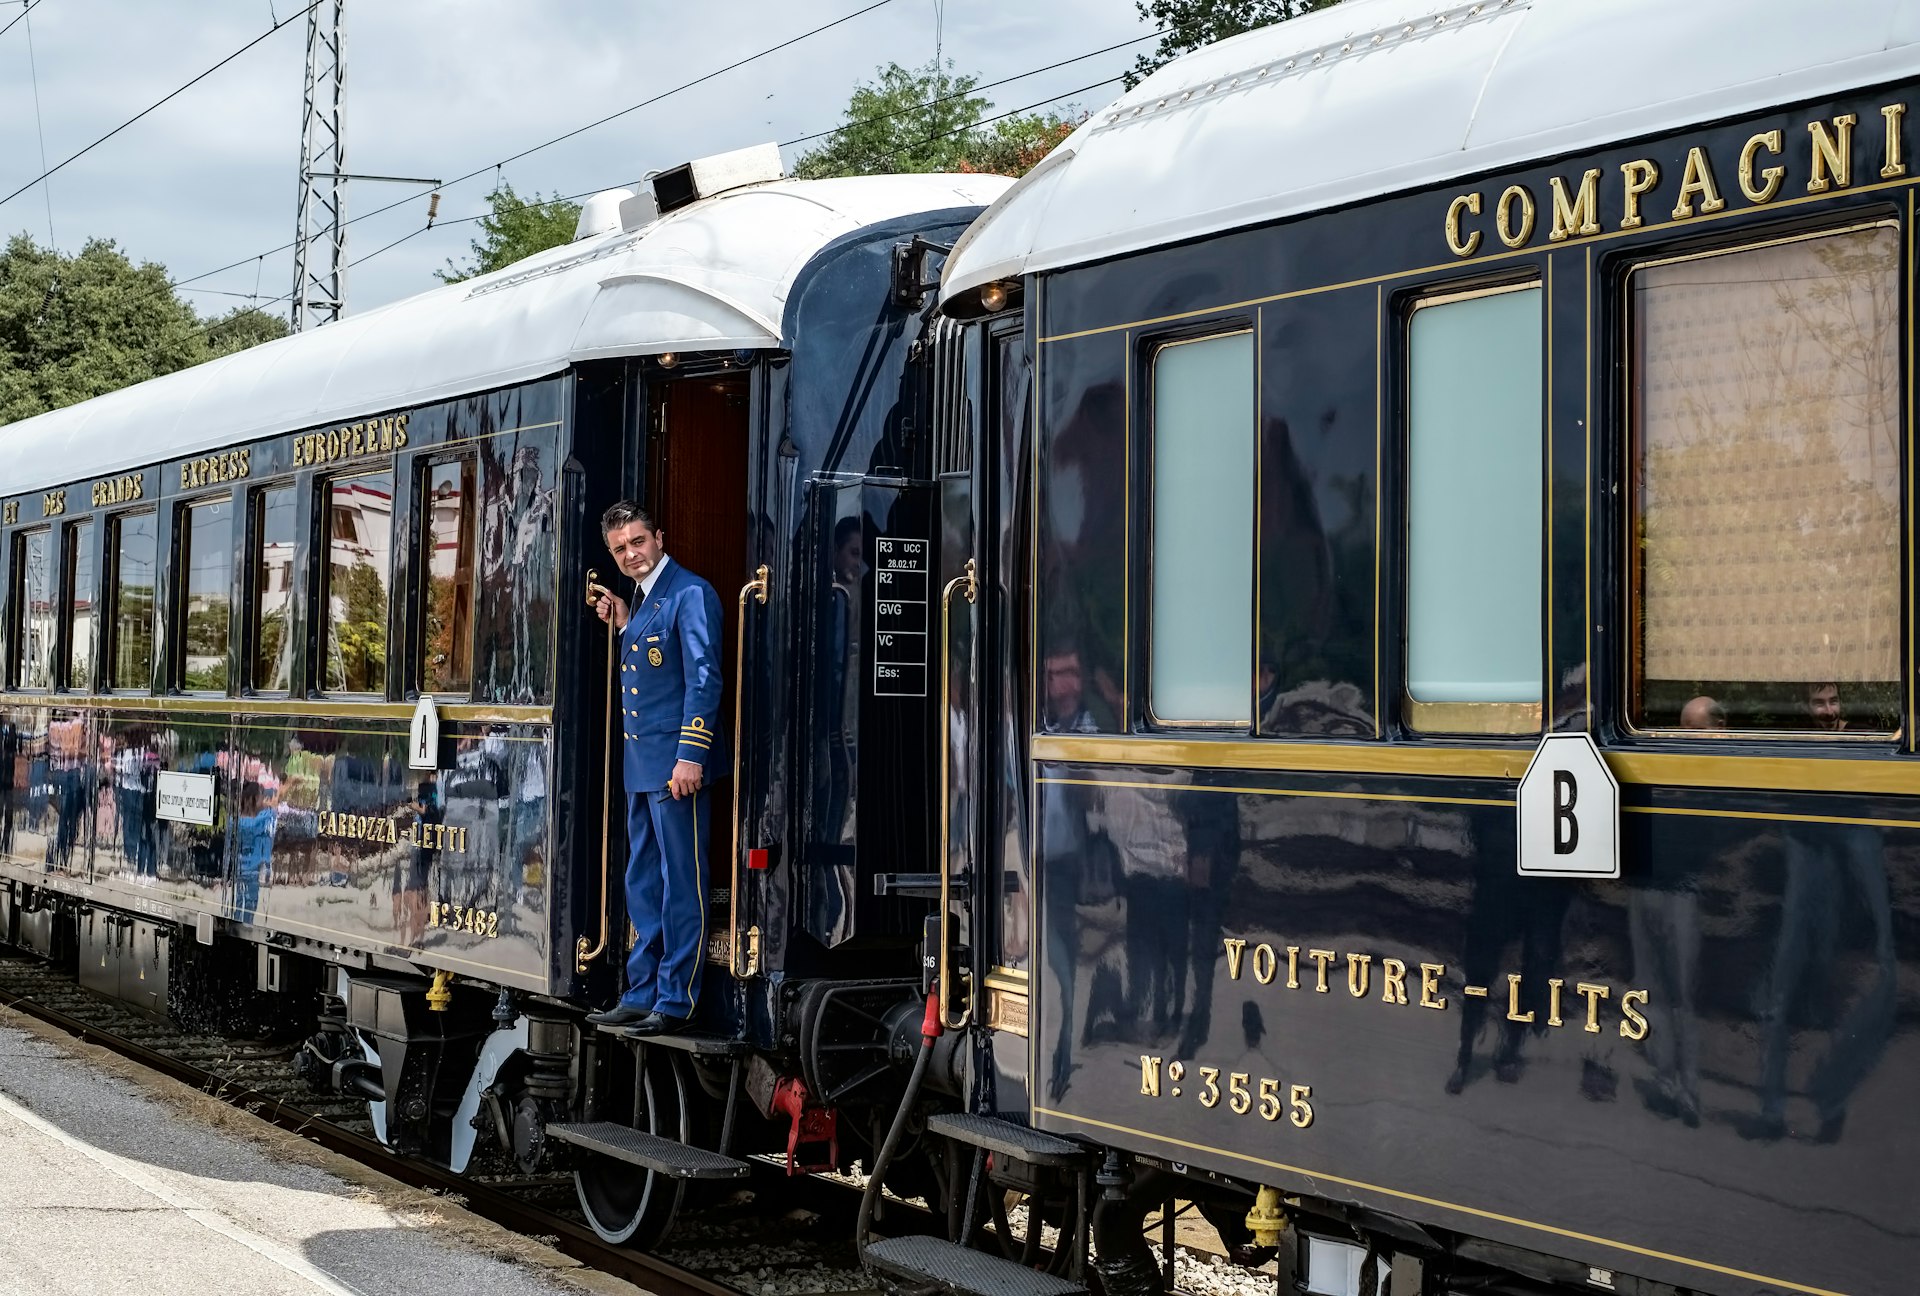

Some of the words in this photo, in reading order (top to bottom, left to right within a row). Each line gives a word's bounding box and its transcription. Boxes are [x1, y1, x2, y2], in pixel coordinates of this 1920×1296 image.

[1444, 103, 1907, 257] COMPAGNI
[4, 501, 19, 525] ET
[43, 490, 65, 517] DES
[91, 473, 143, 507] GRANDS
[180, 449, 250, 490] EXPRESS
[292, 415, 409, 467] EUROPEENS
[879, 541, 893, 553] R3
[903, 543, 921, 553] UCC
[887, 558, 918, 569] 28.02.17
[879, 572, 893, 584] R2
[878, 603, 902, 616] GVG
[878, 634, 893, 647] VC
[878, 666, 900, 678] Ess:
[419, 714, 427, 759] A
[1553, 769, 1579, 855] B
[452, 905, 498, 938] 3482
[1198, 1066, 1314, 1129] 3555
